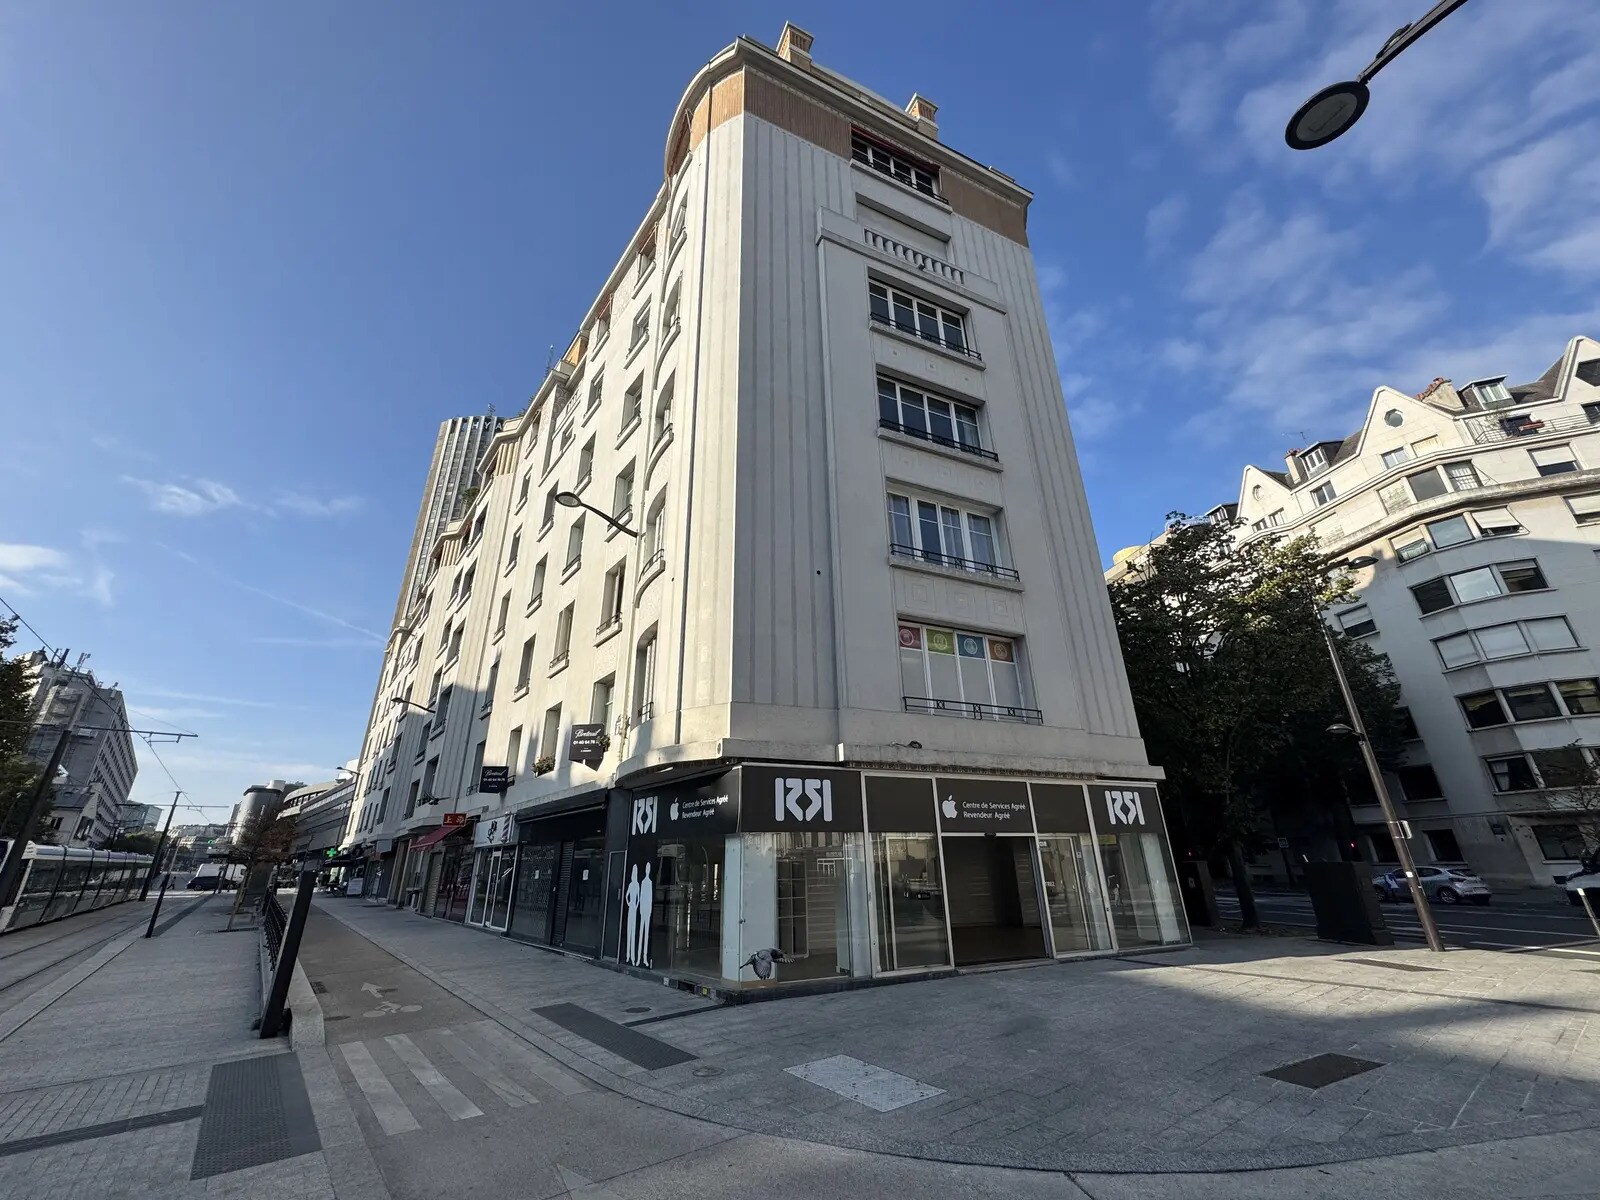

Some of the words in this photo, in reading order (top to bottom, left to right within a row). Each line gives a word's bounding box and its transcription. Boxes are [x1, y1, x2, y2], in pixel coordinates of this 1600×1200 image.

[682, 801, 695, 809] Centre
[695, 799, 700, 807] de
[700, 797, 715, 806] Services
[962, 801, 980, 809] Centre
[682, 810, 702, 819] Revendeur
[963, 811, 992, 819] Revendeur
